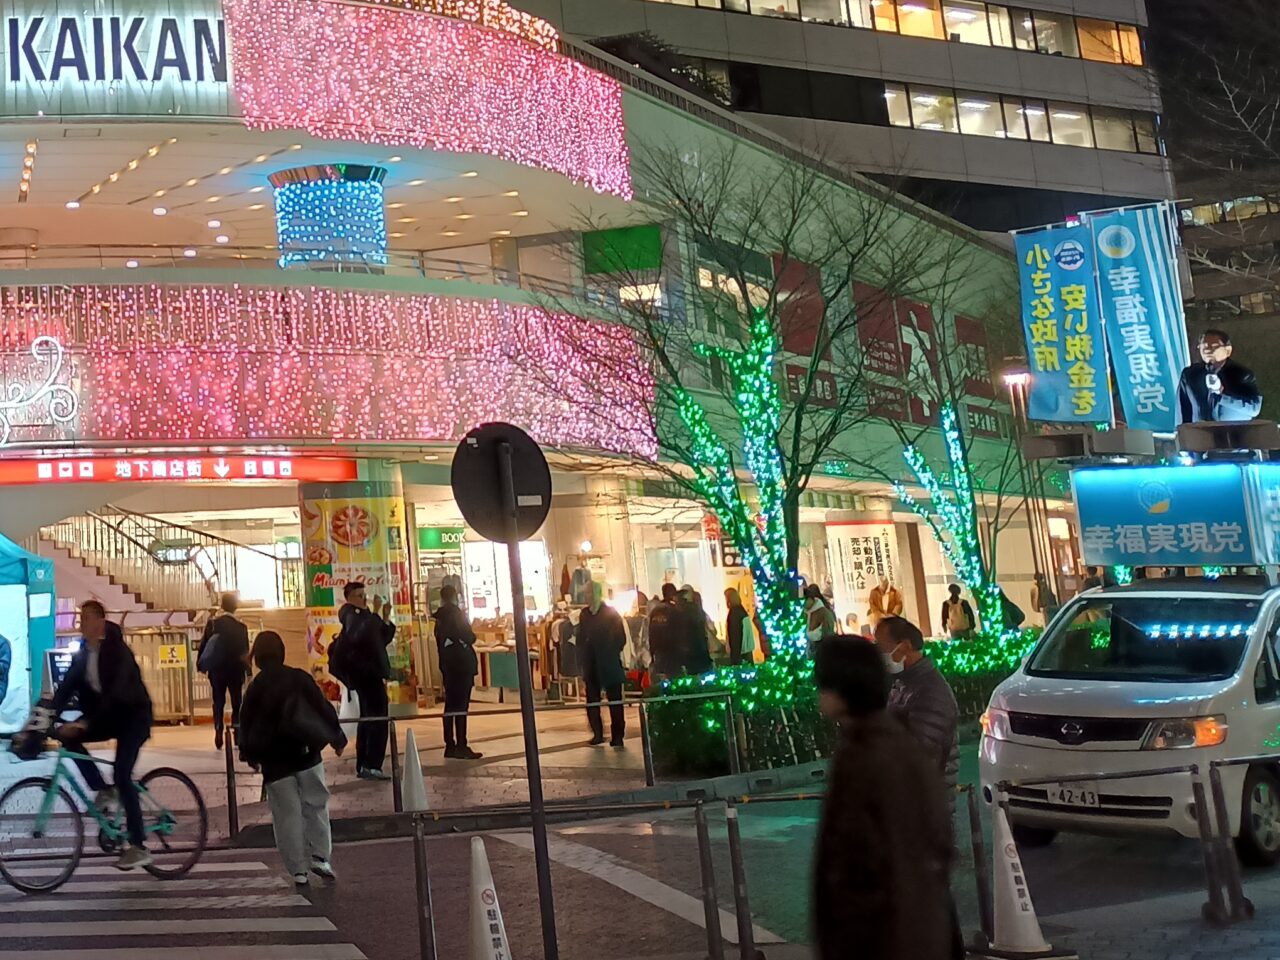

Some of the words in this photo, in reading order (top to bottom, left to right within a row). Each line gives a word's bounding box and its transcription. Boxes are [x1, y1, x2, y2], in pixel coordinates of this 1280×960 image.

[9, 16, 228, 83] KAIKAN
[115, 459, 202, 478] 地下商店街
[1084, 521, 1245, 555] 幸福実現党
[1058, 789, 1096, 805] 42-43
